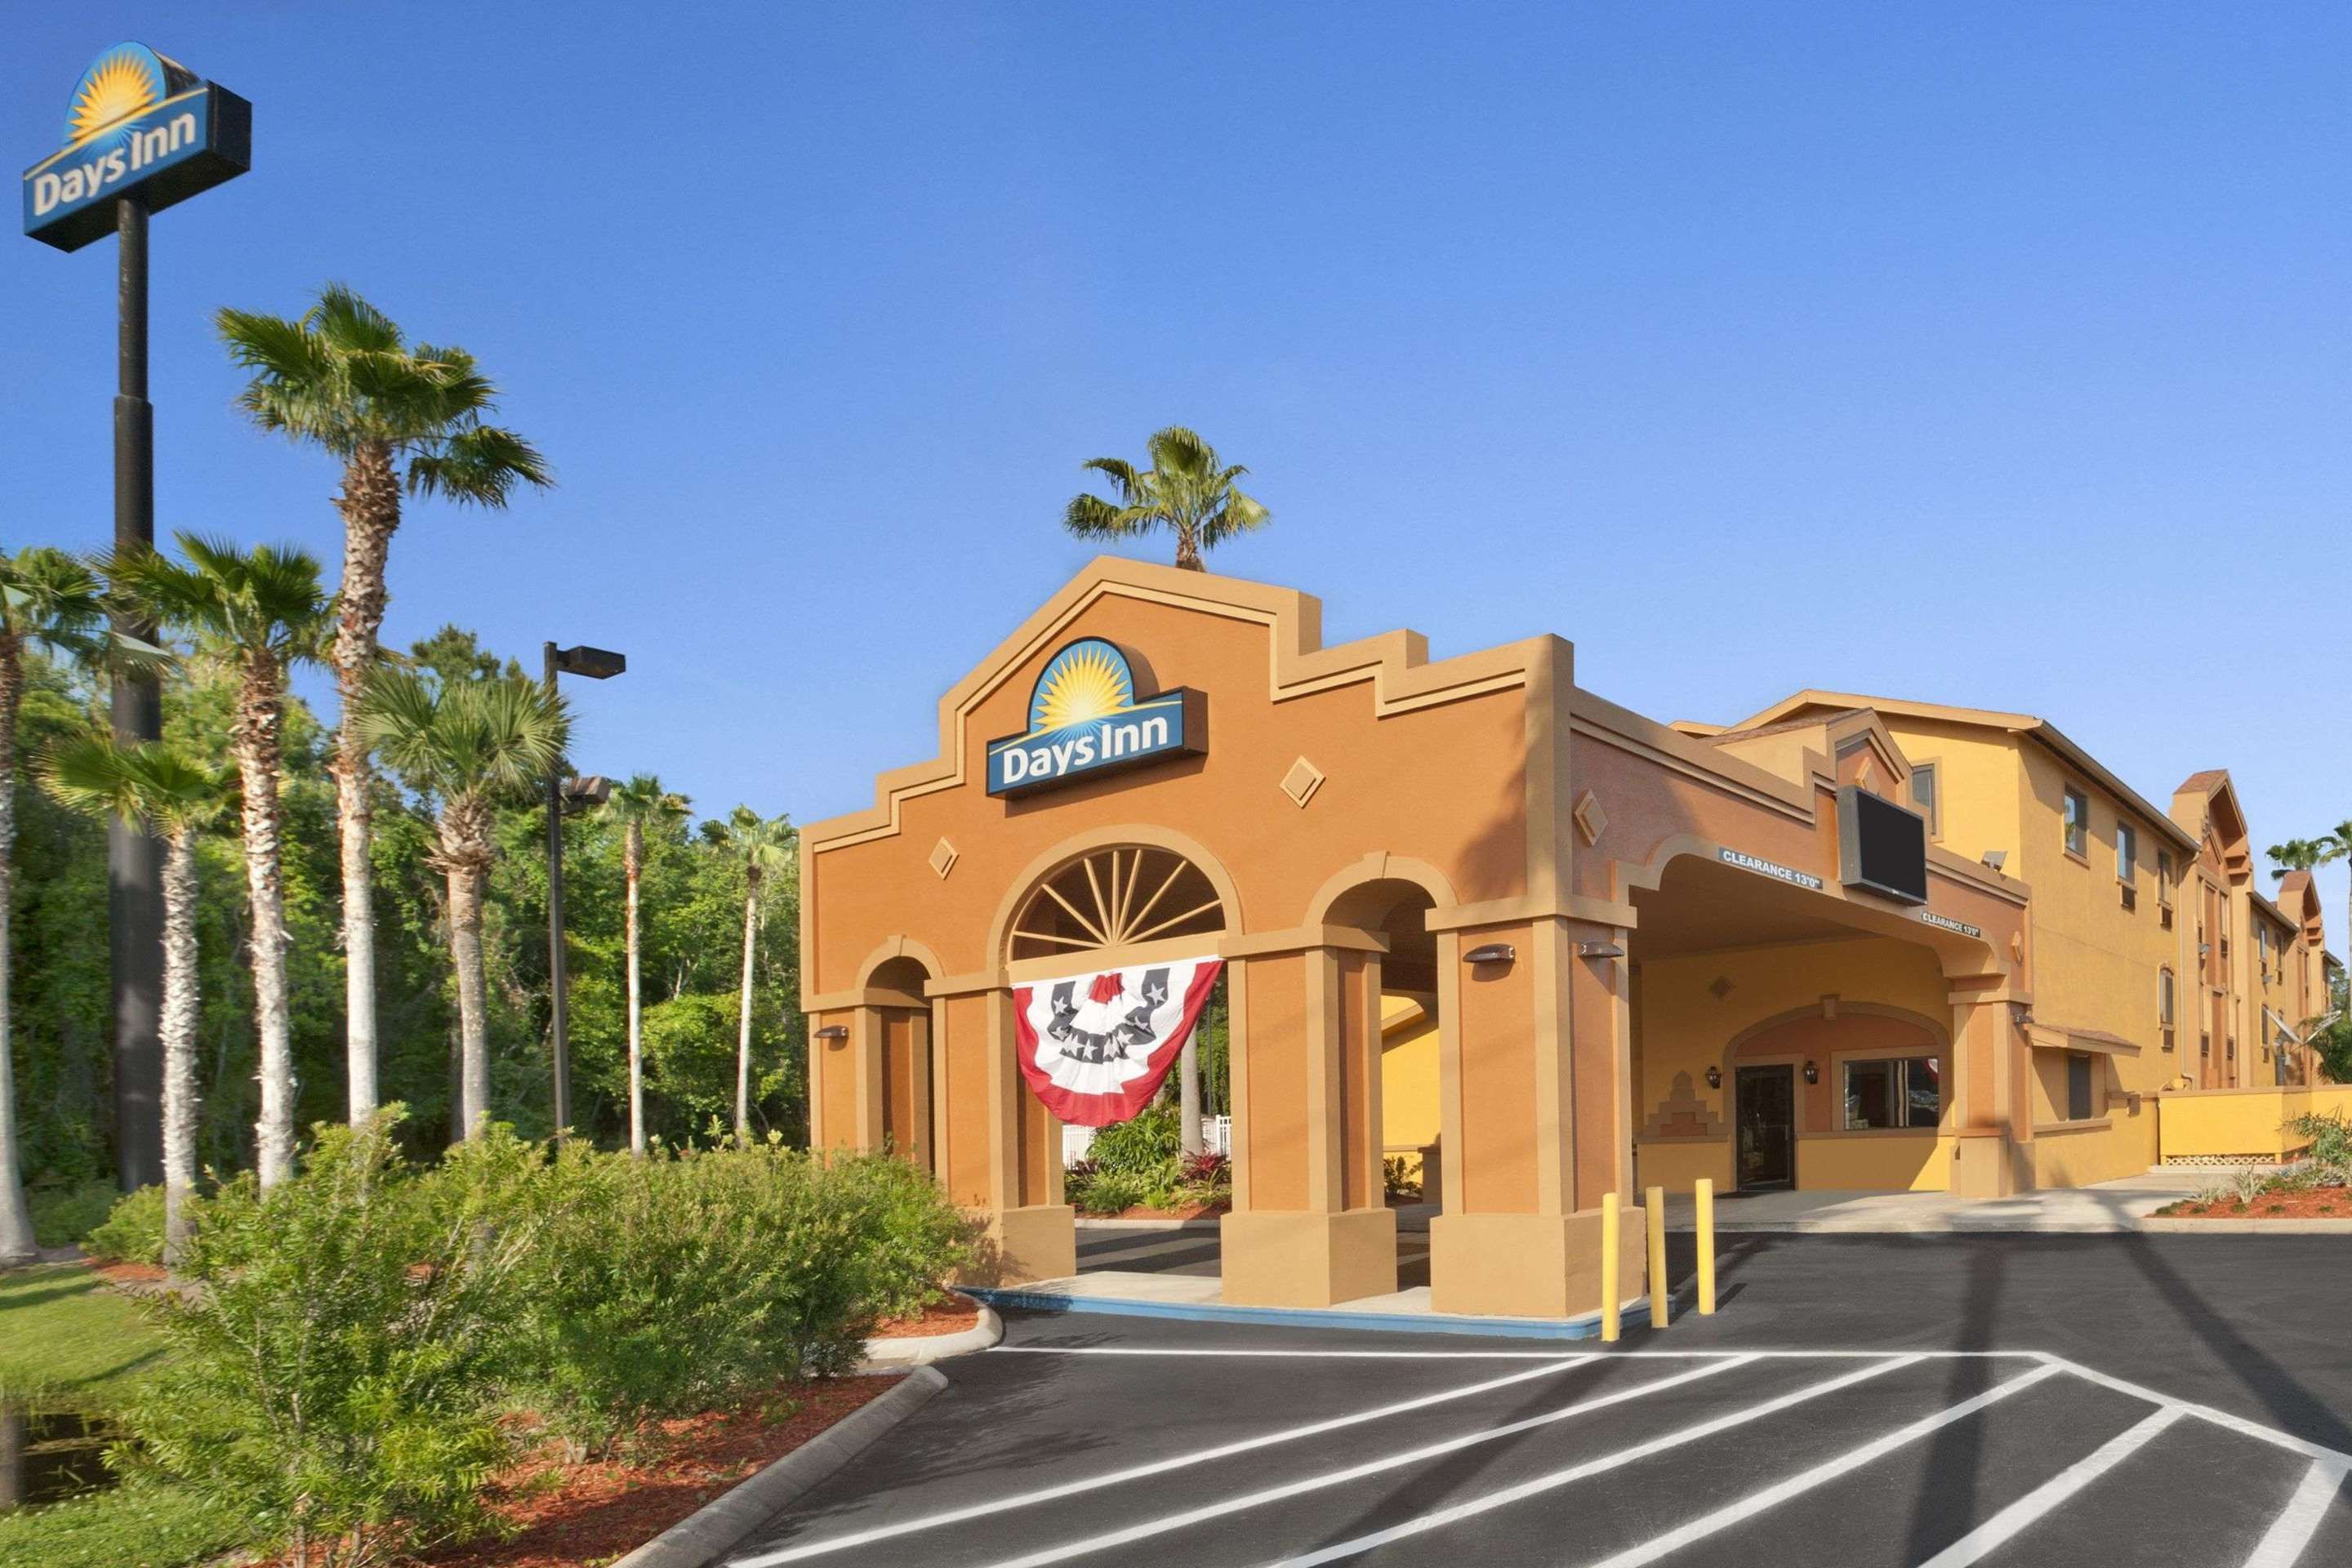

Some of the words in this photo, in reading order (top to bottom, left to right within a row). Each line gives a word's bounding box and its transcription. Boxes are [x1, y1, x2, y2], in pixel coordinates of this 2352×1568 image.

[34, 147, 126, 216] Days
[131, 113, 195, 171] Inn
[1003, 735, 1094, 784] Days
[1101, 716, 1168, 760] Inn
[1723, 850, 1793, 880] CLEARANCE
[1922, 912, 1963, 932] CLEARANCE
